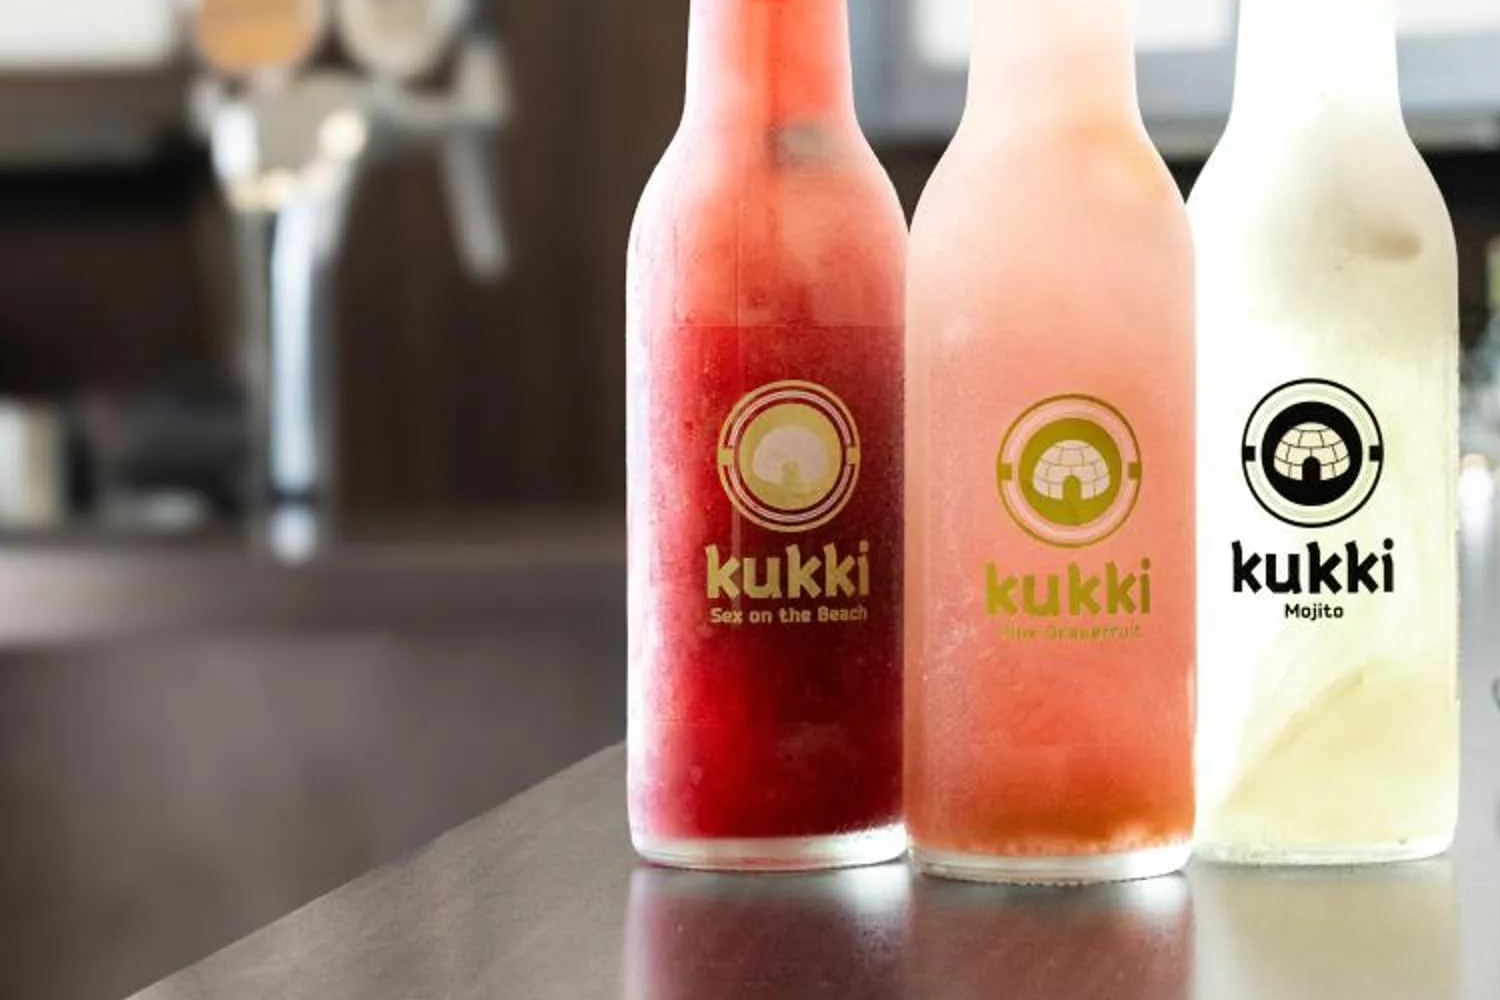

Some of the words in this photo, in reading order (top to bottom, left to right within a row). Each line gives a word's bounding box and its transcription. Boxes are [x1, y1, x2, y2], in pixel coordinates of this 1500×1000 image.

[705, 540, 870, 599] kukki
[985, 557, 1151, 617] kukki
[1231, 538, 1394, 594] kukki
[710, 607, 743, 624] Sex
[750, 610, 772, 623] on
[779, 607, 811, 623] the
[817, 604, 868, 622] Beach
[1284, 603, 1344, 621] Mojito
